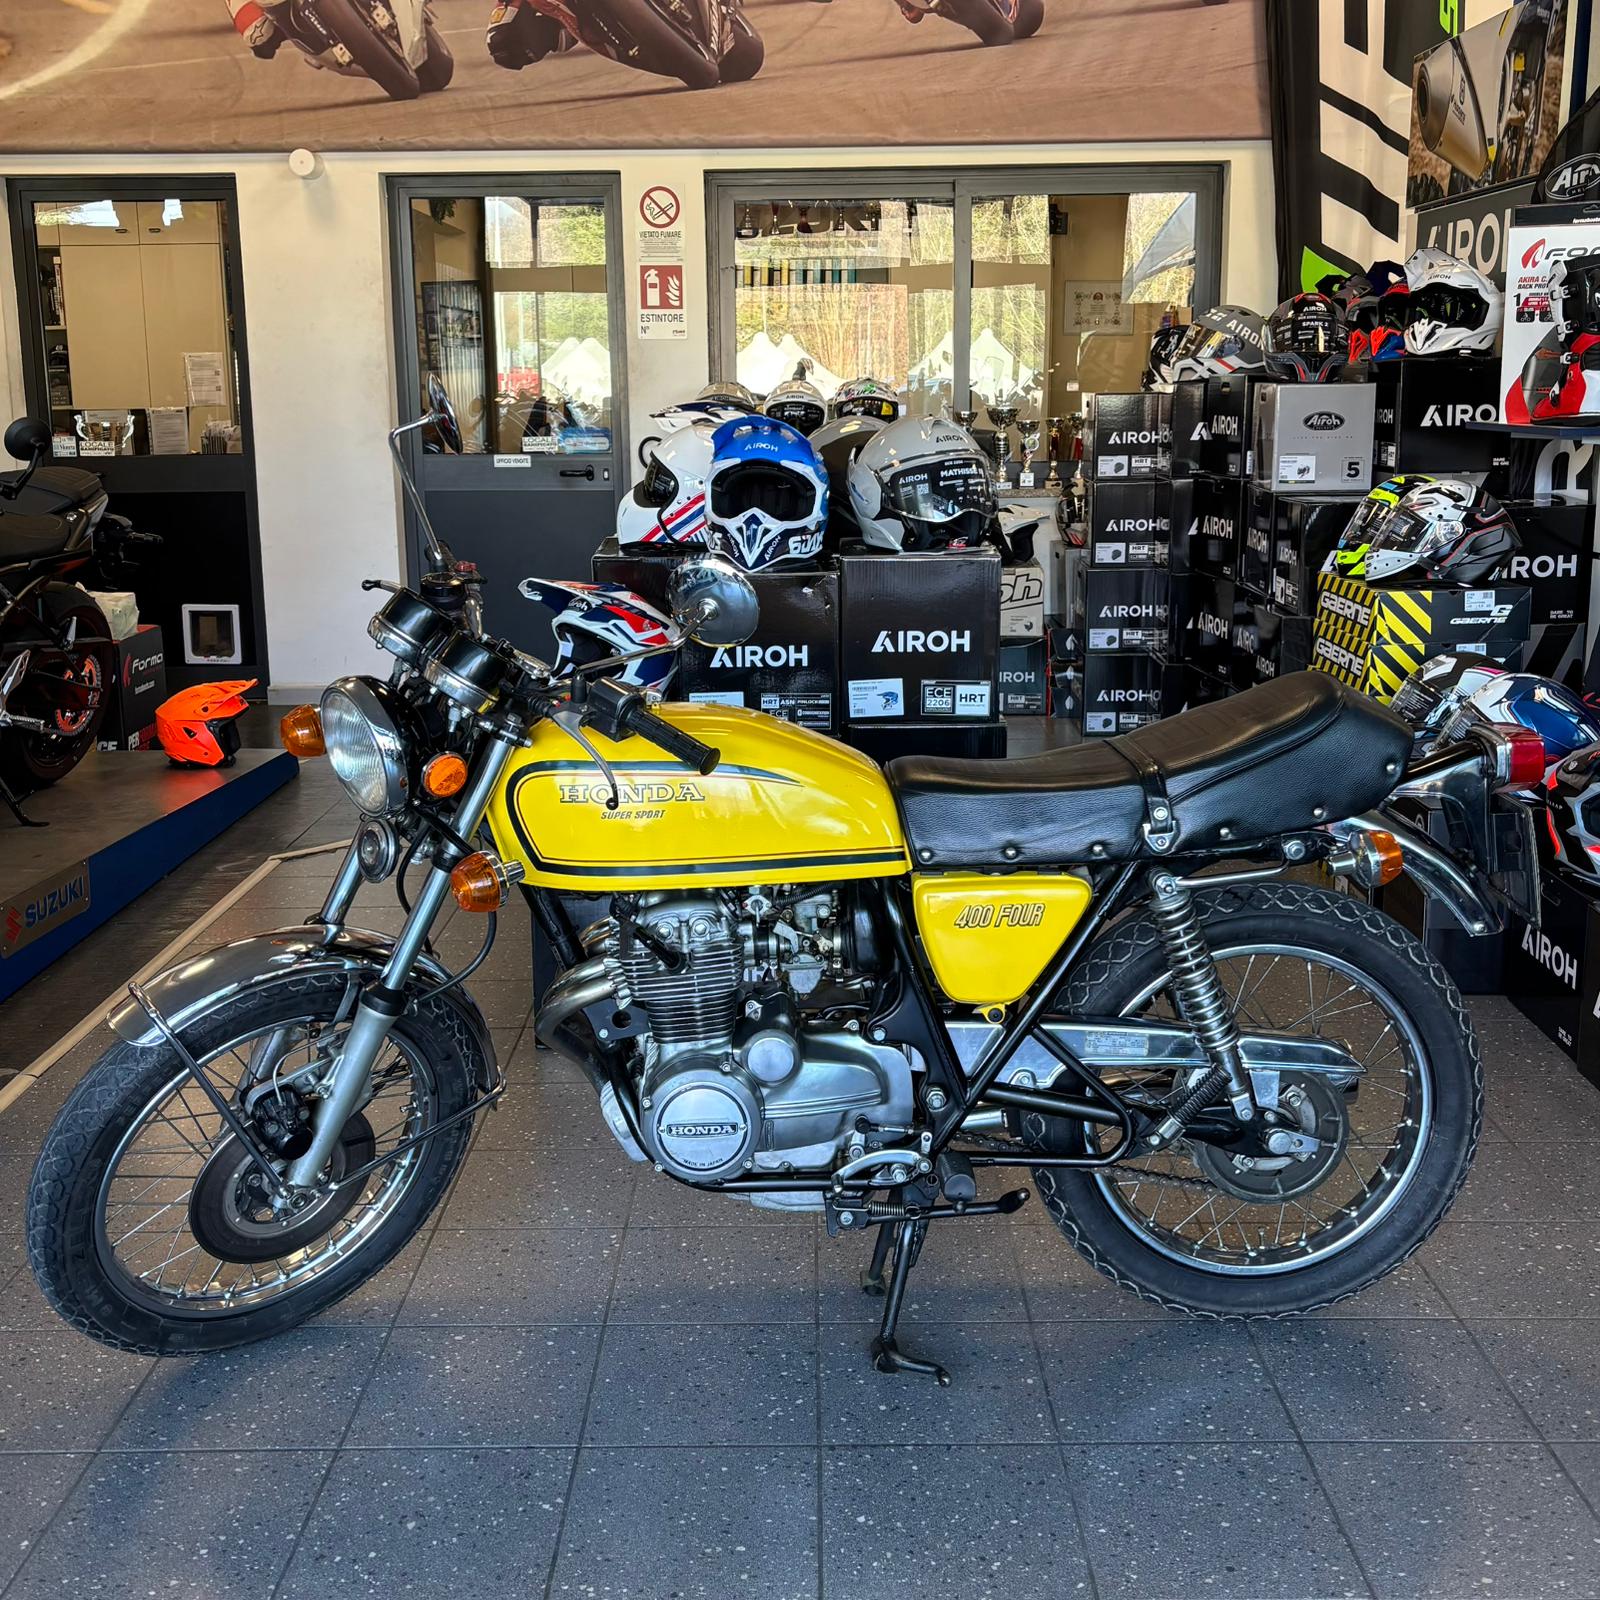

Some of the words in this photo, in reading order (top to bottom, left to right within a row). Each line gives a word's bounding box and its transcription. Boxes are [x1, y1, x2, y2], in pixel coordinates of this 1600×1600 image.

[639, 230, 659, 239] VIETATO
[660, 230, 682, 239] FUMARE
[640, 313, 684, 323] ESTINTORE
[1420, 404, 1497, 428] AIRO
[1211, 415, 1239, 436] AIROH
[1108, 431, 1161, 444] AIROH
[744, 443, 779, 452] AIROH
[940, 467, 978, 478] MATHISSE
[1346, 461, 1360, 478] 5
[899, 473, 928, 485] AIROH
[1105, 519, 1159, 532] AIROH
[1202, 515, 1233, 540] AIROH
[764, 534, 782, 561] AIROH
[1099, 605, 1153, 618] AIROH
[1320, 590, 1371, 627] GAERNE
[1197, 612, 1229, 640] AIROH
[1450, 616, 1508, 625] GAERNE
[871, 630, 970, 653] AIROH
[709, 644, 808, 668] AIROH
[1316, 637, 1364, 676] GAERNE
[1256, 655, 1275, 678] AIROH
[999, 672, 1035, 682] IROH
[926, 687, 952, 698] ECE
[959, 693, 986, 703] HRT
[1096, 690, 1149, 702] AIROH
[763, 698, 778, 706] HRT
[780, 698, 796, 706] ASN
[927, 699, 950, 707] 2206
[560, 783, 705, 804] HONDA
[601, 811, 631, 820] SUPER
[634, 810, 666, 819] SPORT
[24, 875, 84, 929] SUZUKI
[954, 904, 995, 929] 400
[994, 903, 1046, 928] FOUR
[1521, 923, 1578, 990] AIROH
[671, 1125, 735, 1135] HONDA
[682, 1158, 698, 1167] MADE
[707, 1158, 724, 1167] JAPAN
